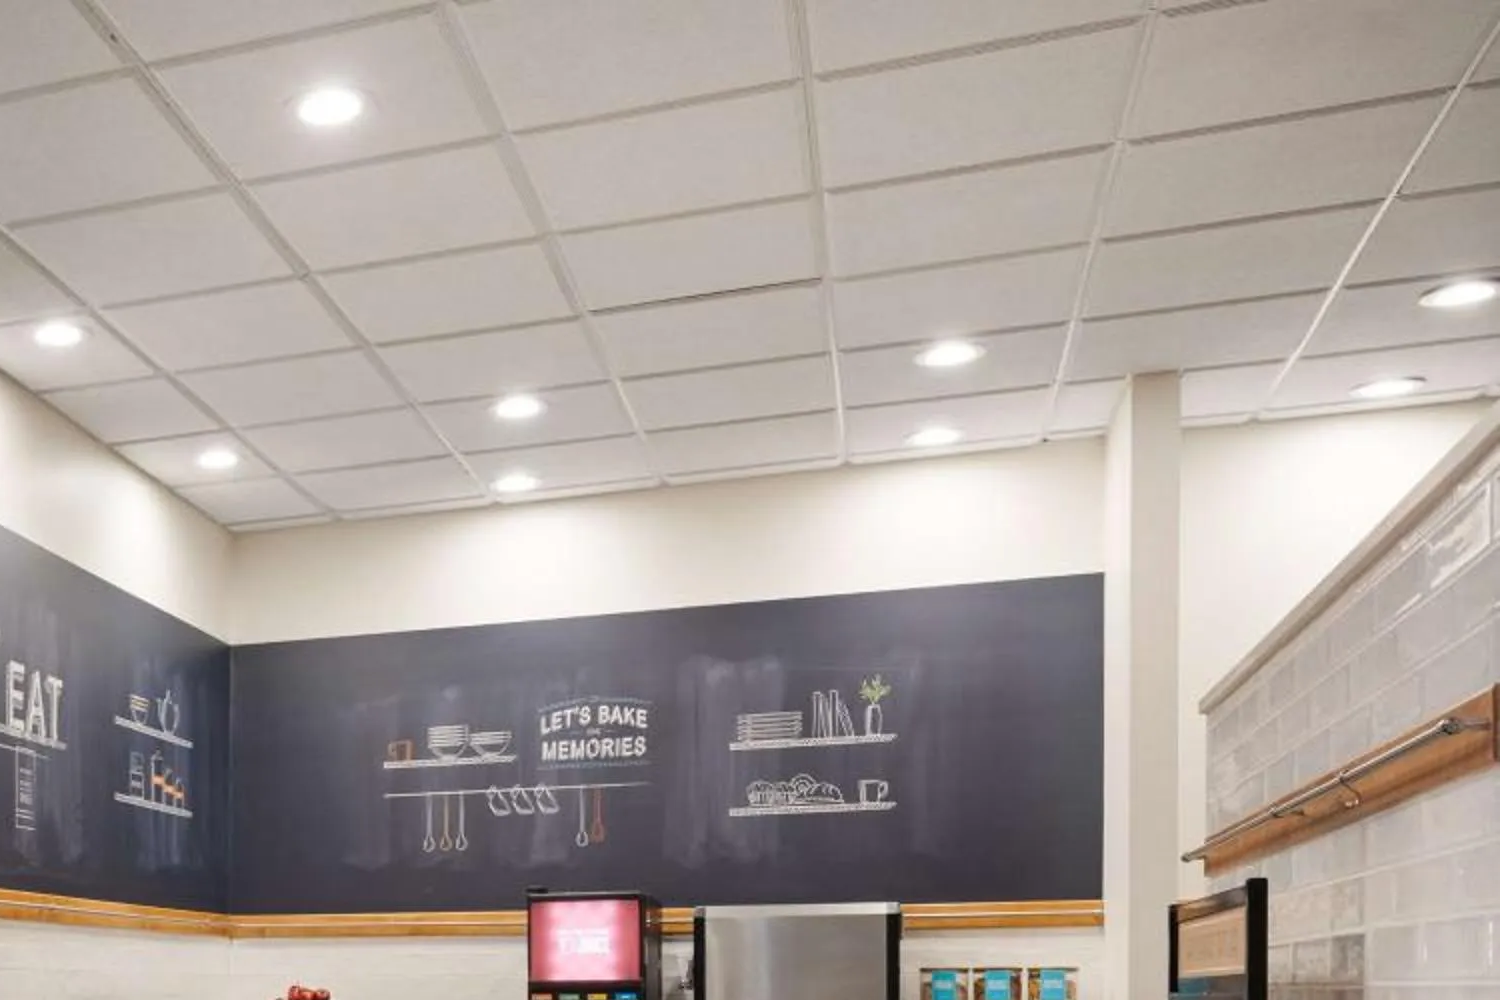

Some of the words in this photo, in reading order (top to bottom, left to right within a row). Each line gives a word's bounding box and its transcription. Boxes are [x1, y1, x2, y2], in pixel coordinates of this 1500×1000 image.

[5, 660, 64, 745] EAT
[541, 705, 591, 736] LET'S
[599, 704, 648, 729] BAKE
[541, 735, 647, 761] MEMORIES
